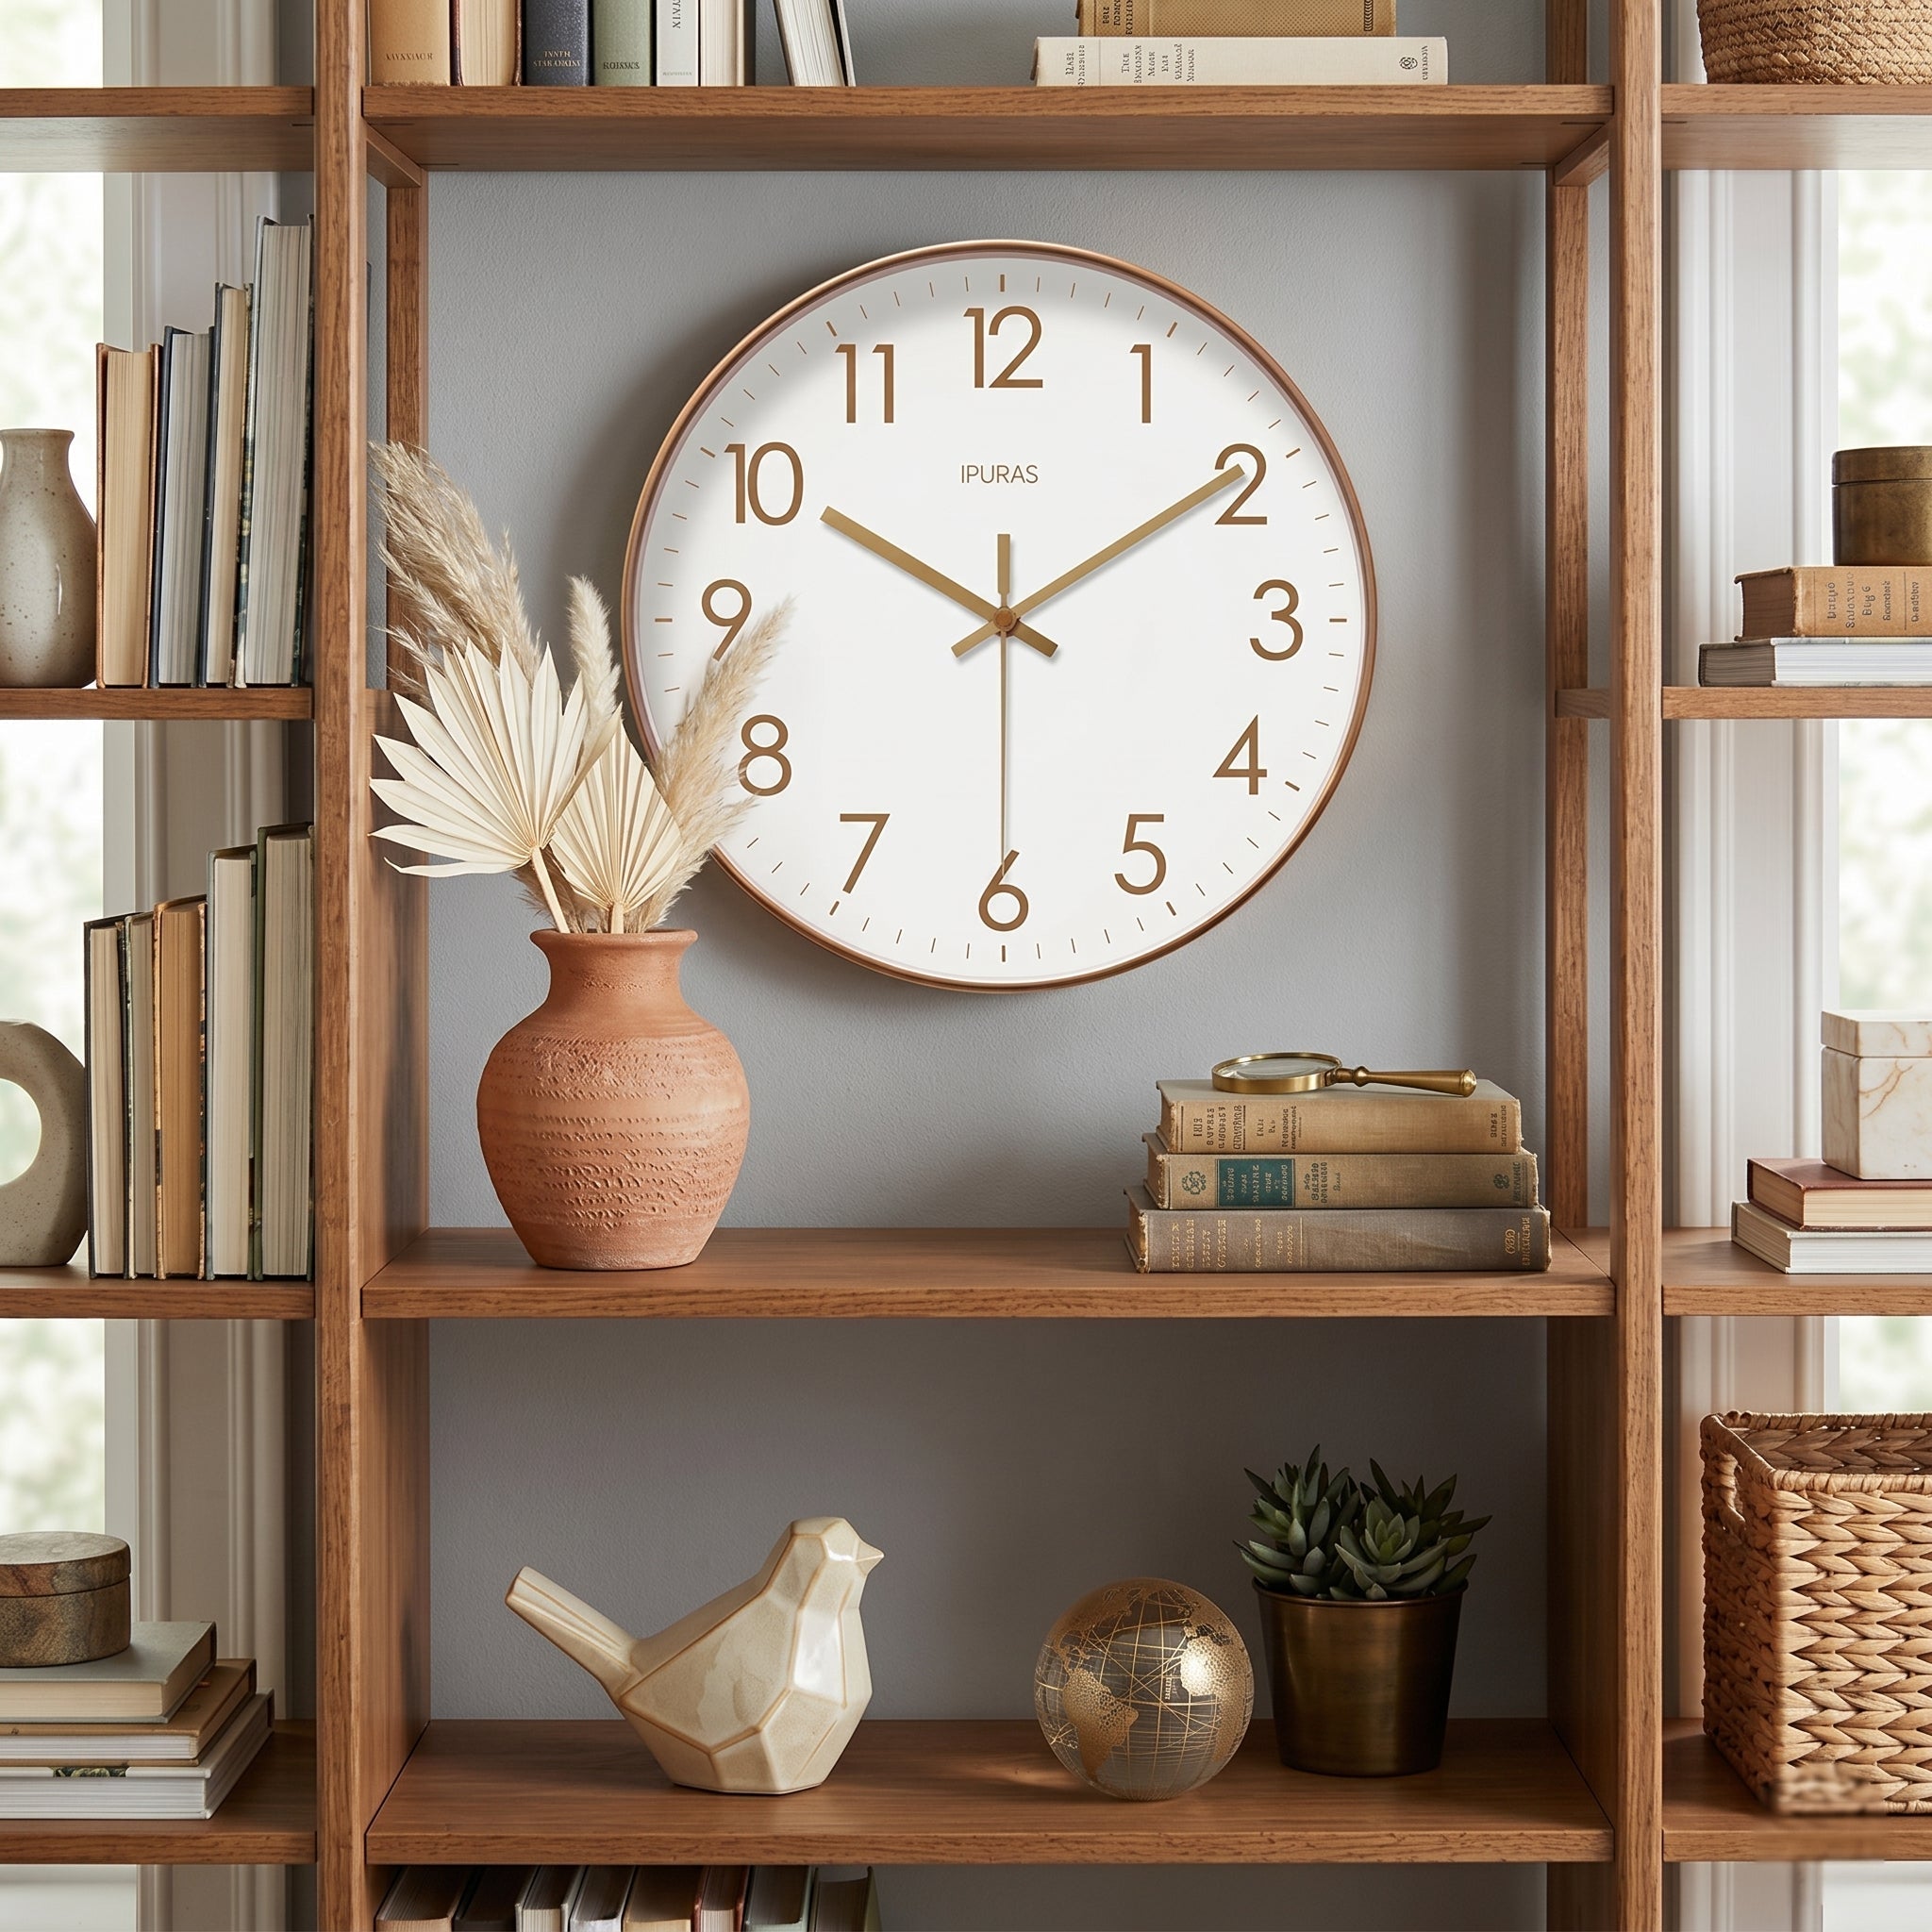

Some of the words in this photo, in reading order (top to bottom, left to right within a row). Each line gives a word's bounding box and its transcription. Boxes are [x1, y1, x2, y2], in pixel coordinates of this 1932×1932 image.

[835, 343, 894, 424] 11
[963, 306, 1042, 389] 12
[1130, 344, 1152, 425] 1
[724, 442, 804, 525] 10
[960, 464, 1039, 484] IPURAS
[1214, 443, 1267, 525] 2
[701, 579, 752, 660] 9
[1250, 579, 1303, 660] 3
[739, 714, 792, 796] 8
[1212, 714, 1267, 795] 4
[839, 813, 891, 894] 7
[978, 849, 1028, 932] 6
[1114, 814, 1167, 895] 5
